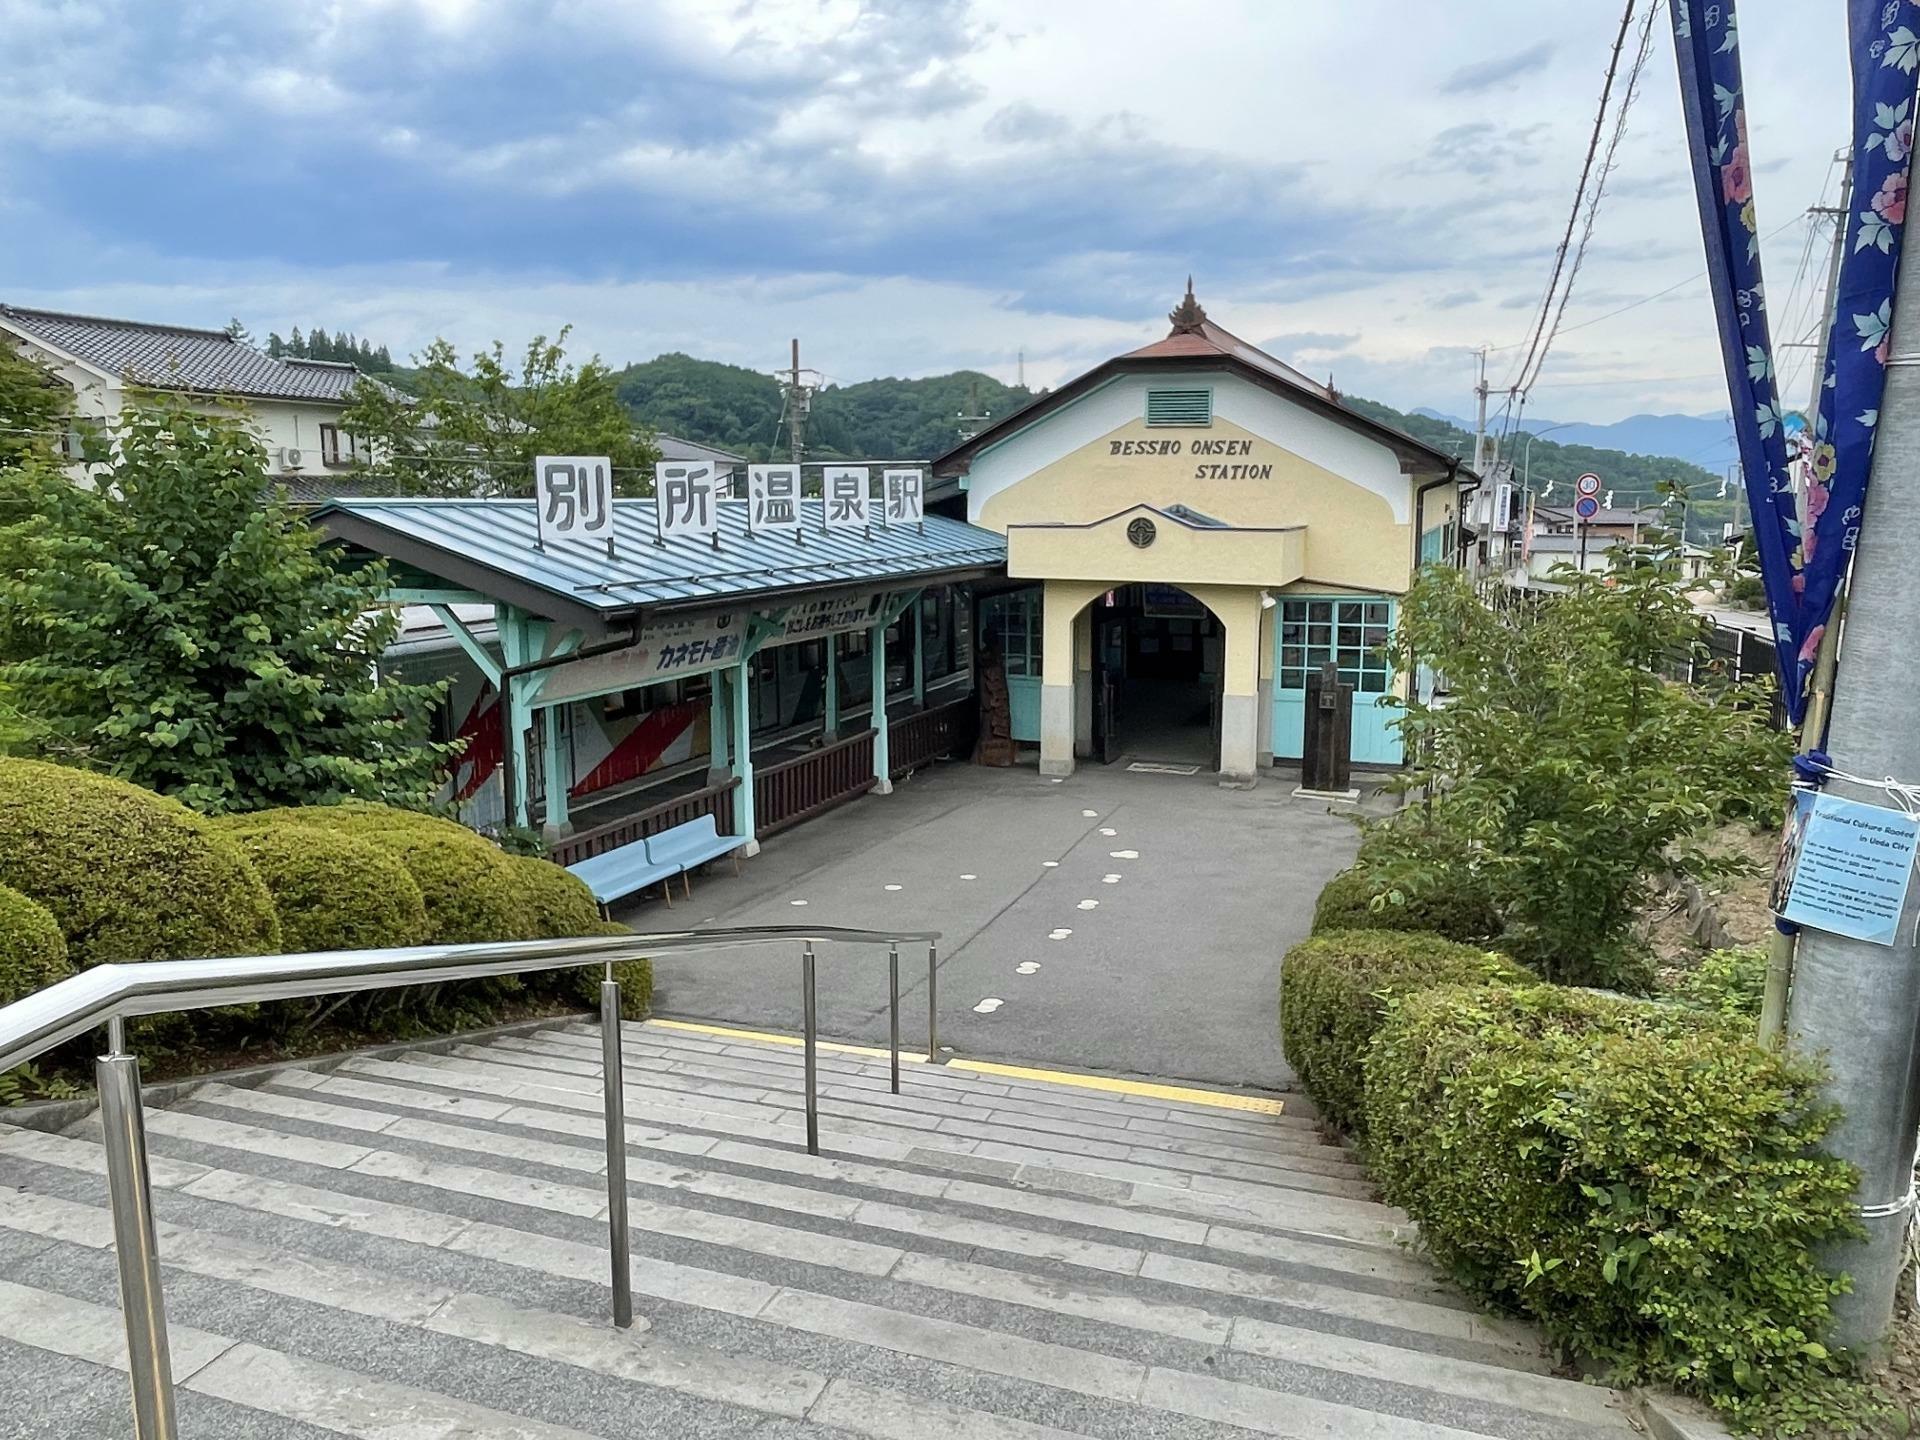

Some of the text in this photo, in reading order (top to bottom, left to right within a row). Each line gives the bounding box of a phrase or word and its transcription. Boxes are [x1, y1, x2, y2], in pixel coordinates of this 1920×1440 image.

[1109, 440, 1253, 456] BESSHO ONSEN
[1194, 465, 1273, 480] STATION
[1582, 479, 1595, 490] 30
[544, 463, 920, 533] 別所温泉駅
[1815, 810, 1915, 839] Traditional Culture Rooted
[1859, 834, 1910, 852] in Ueda City
